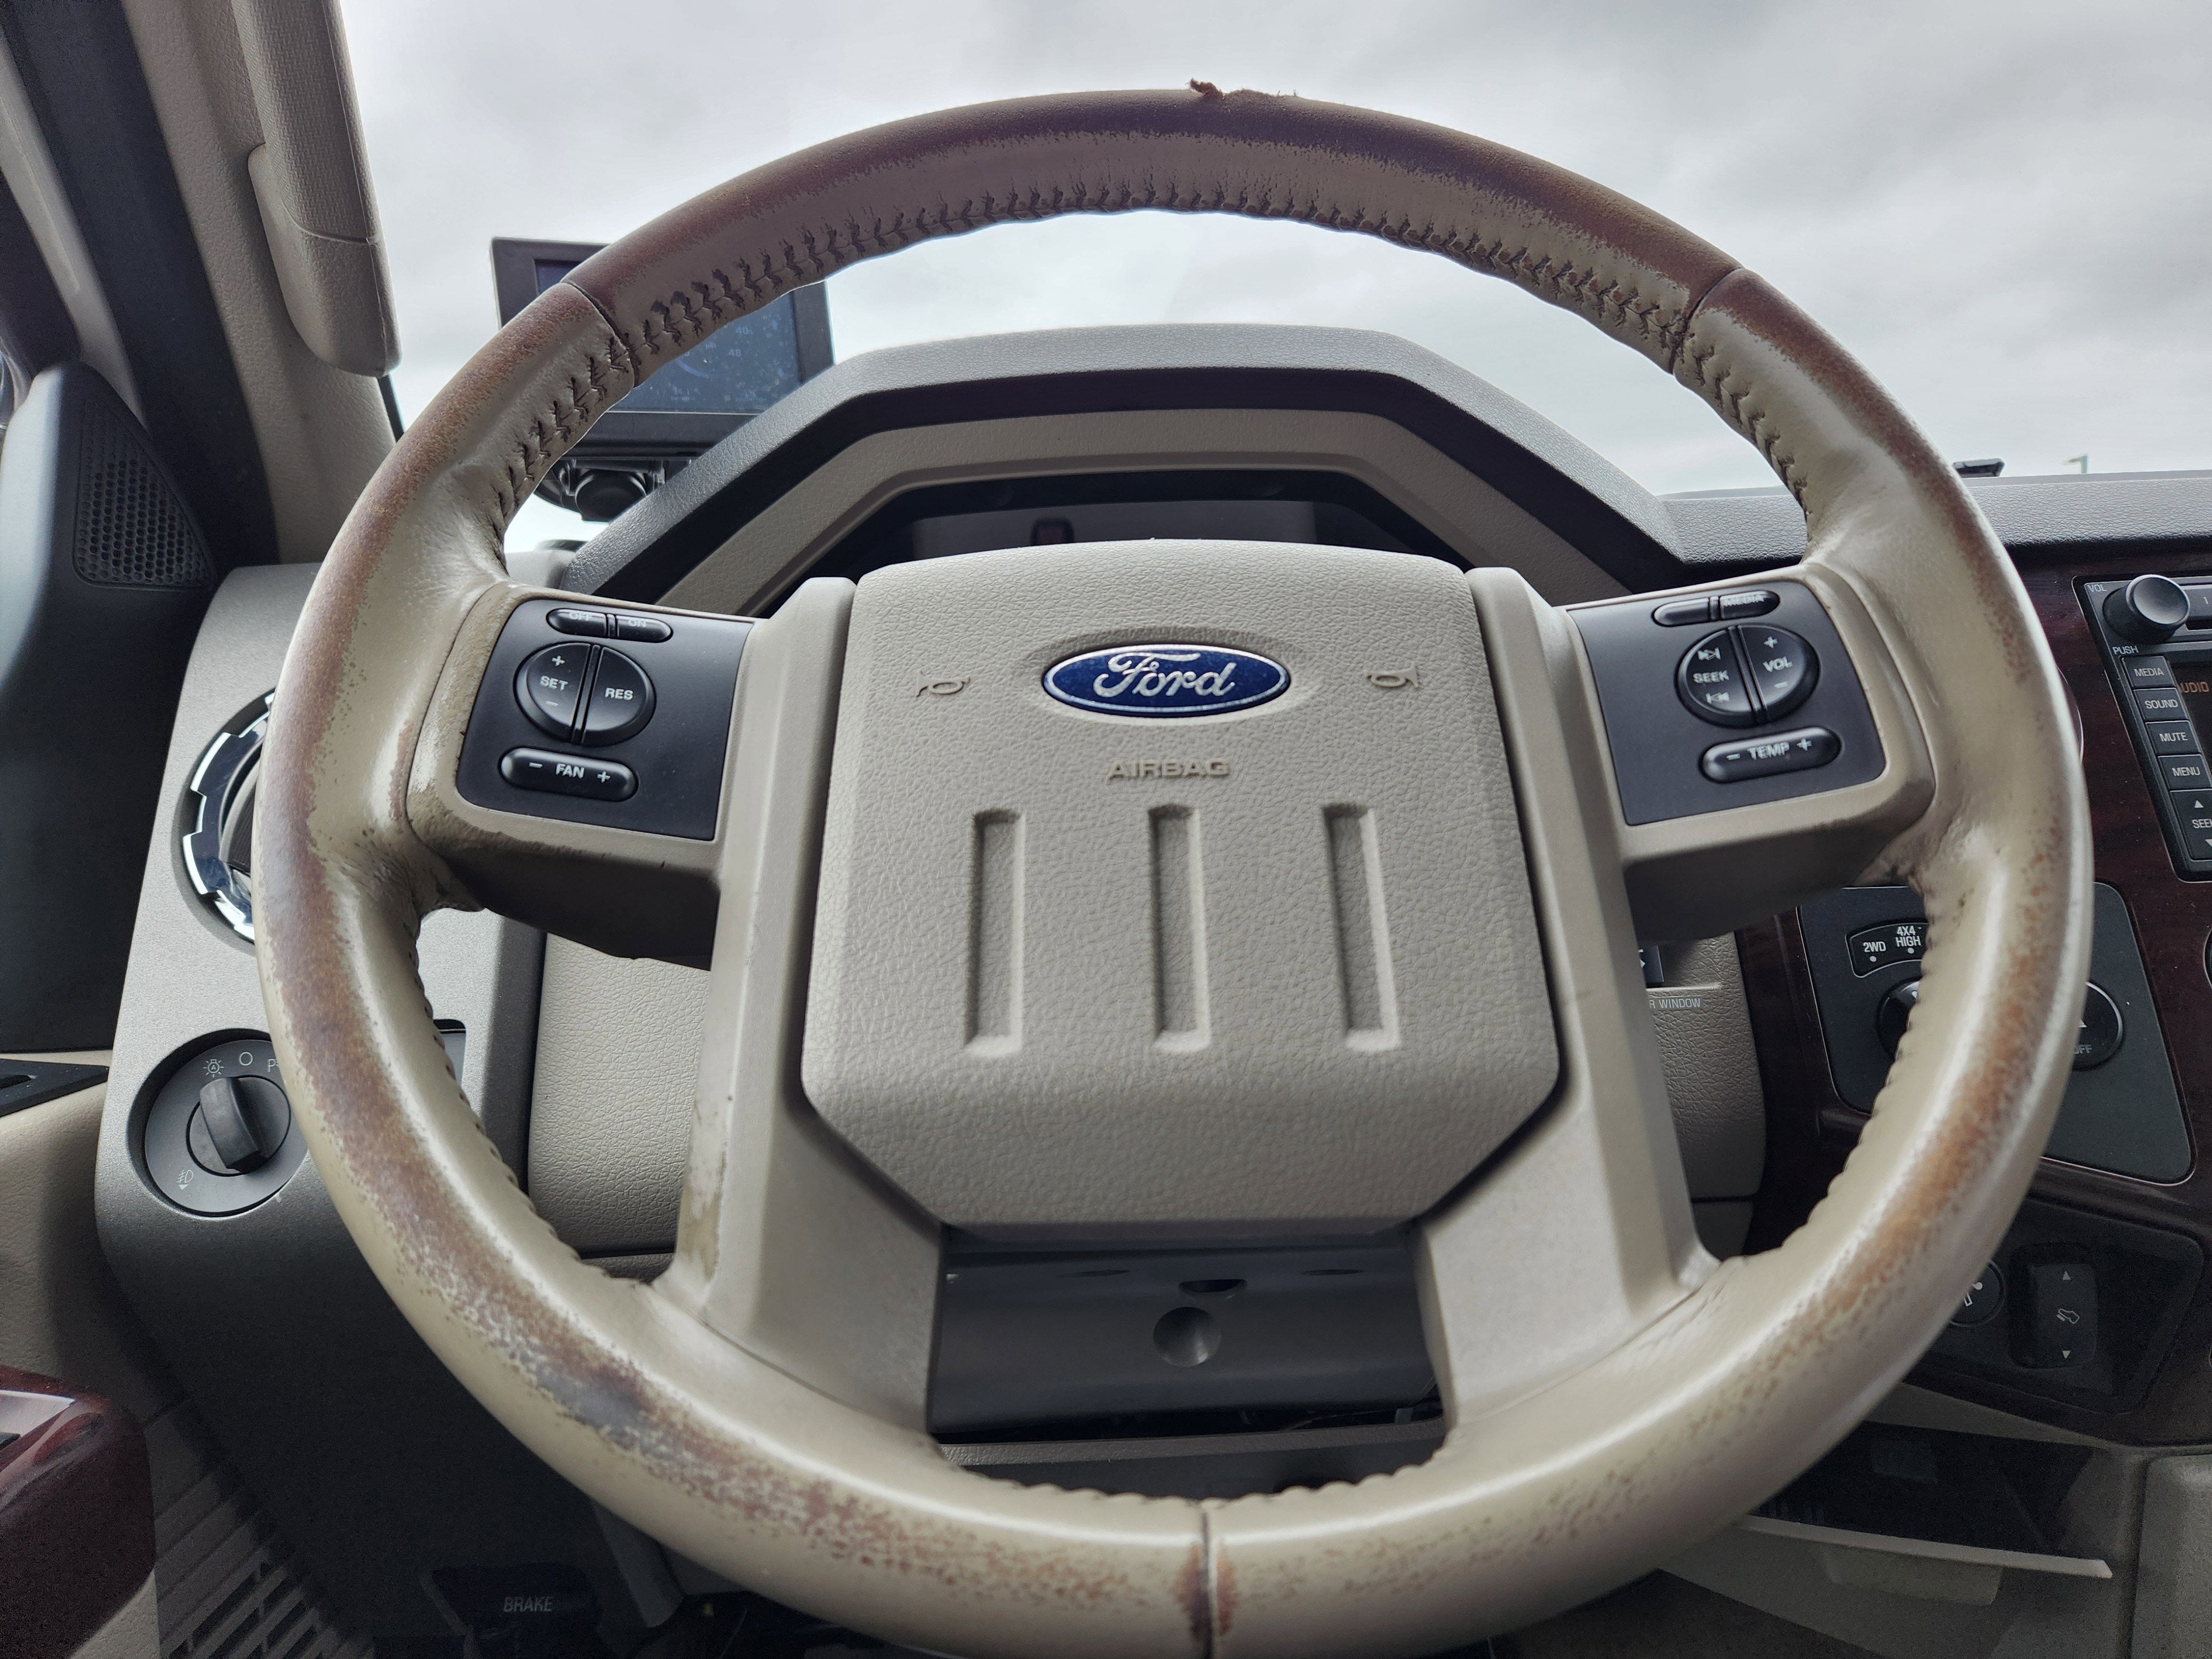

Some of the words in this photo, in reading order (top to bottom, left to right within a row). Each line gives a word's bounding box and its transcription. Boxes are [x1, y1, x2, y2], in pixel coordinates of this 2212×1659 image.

[2088, 585, 2107, 593] VOL
[569, 612, 593, 622] OFF
[628, 619, 647, 628] ON
[2112, 645, 2139, 655] PUSH
[1763, 656, 1793, 673] VOL
[1093, 651, 1237, 697] Ford
[1693, 670, 1730, 684] SEEK
[2134, 667, 2164, 677] MEDIA
[540, 675, 568, 691] SET
[605, 687, 634, 701] RES
[2145, 699, 2179, 709] SOUND
[2159, 732, 2188, 742] MUTE
[1747, 742, 1790, 760] TEMP
[555, 764, 585, 779] FAN
[1108, 760, 1230, 779] AIRBAG
[2172, 766, 2200, 776] MENU
[1896, 925, 1916, 936] 4X4
[1863, 941, 1886, 953] 2WD
[1895, 936, 1922, 947] HIGH
[1659, 998, 1700, 1009] WINDOW
[503, 1596, 552, 1613] BRAKE
